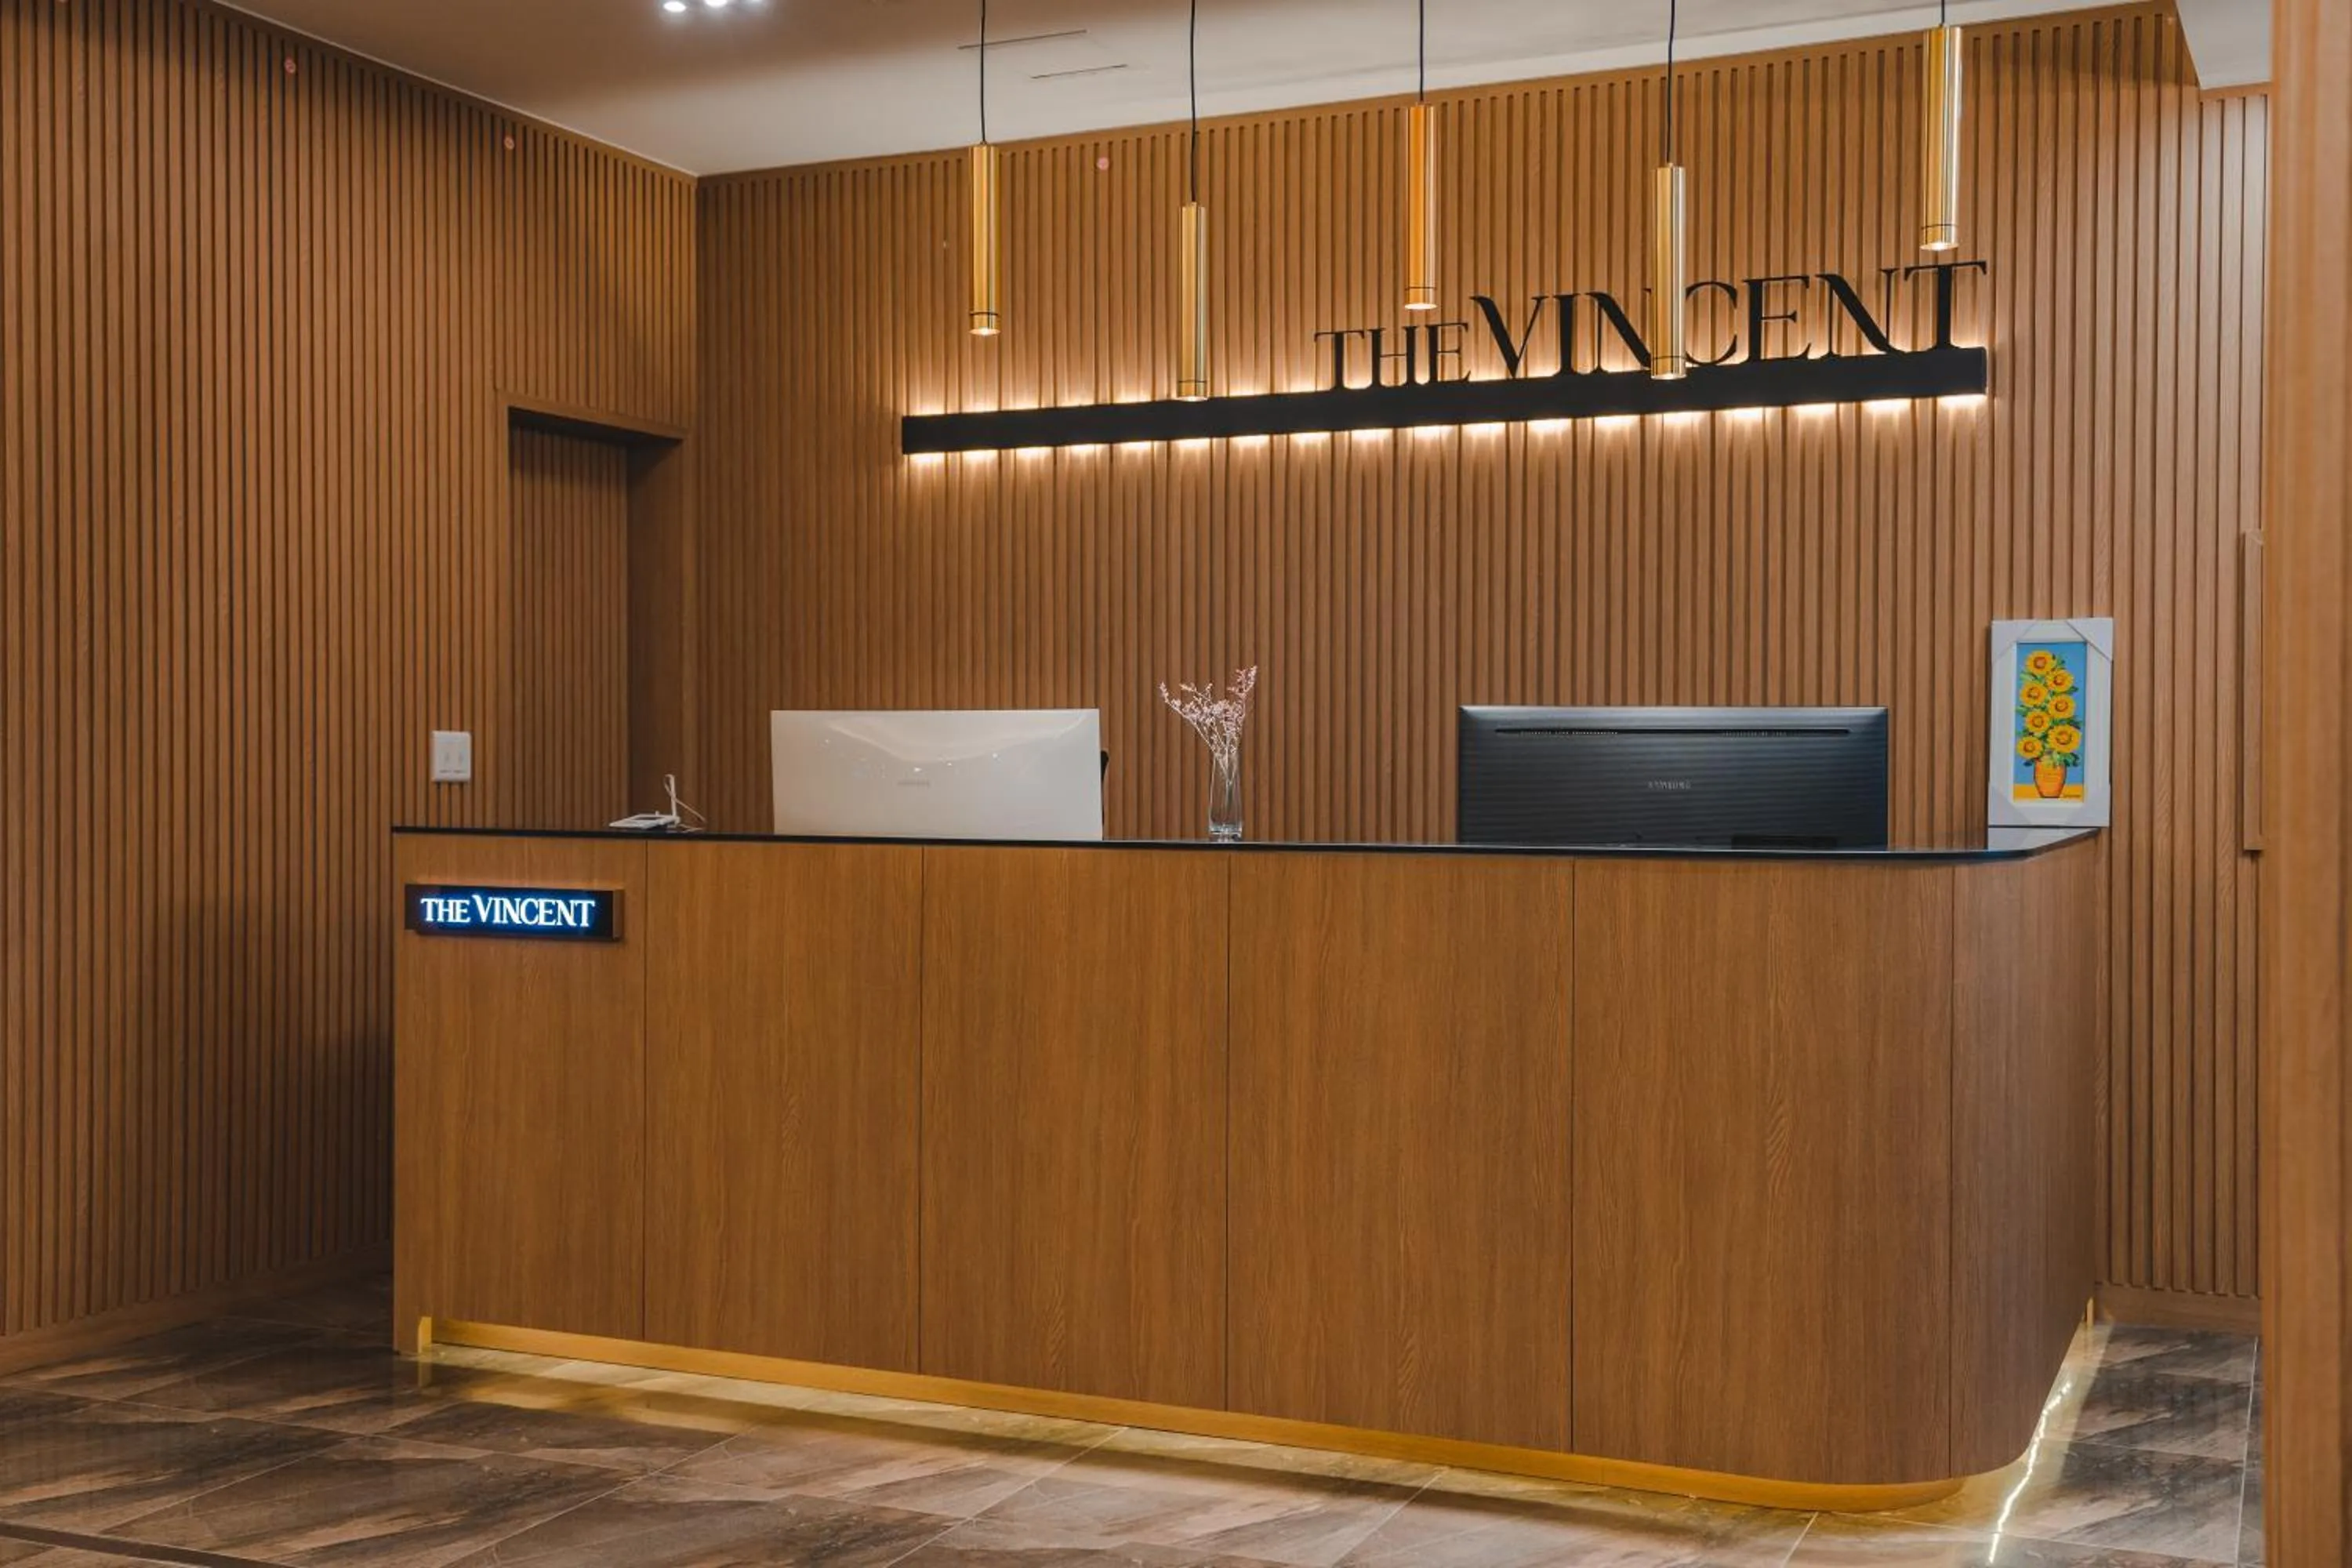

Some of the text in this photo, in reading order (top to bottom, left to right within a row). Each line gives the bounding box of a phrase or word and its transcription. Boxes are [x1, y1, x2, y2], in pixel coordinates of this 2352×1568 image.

[1315, 260, 1987, 390] THE VINCENT
[420, 895, 595, 927] THE VINCENT
